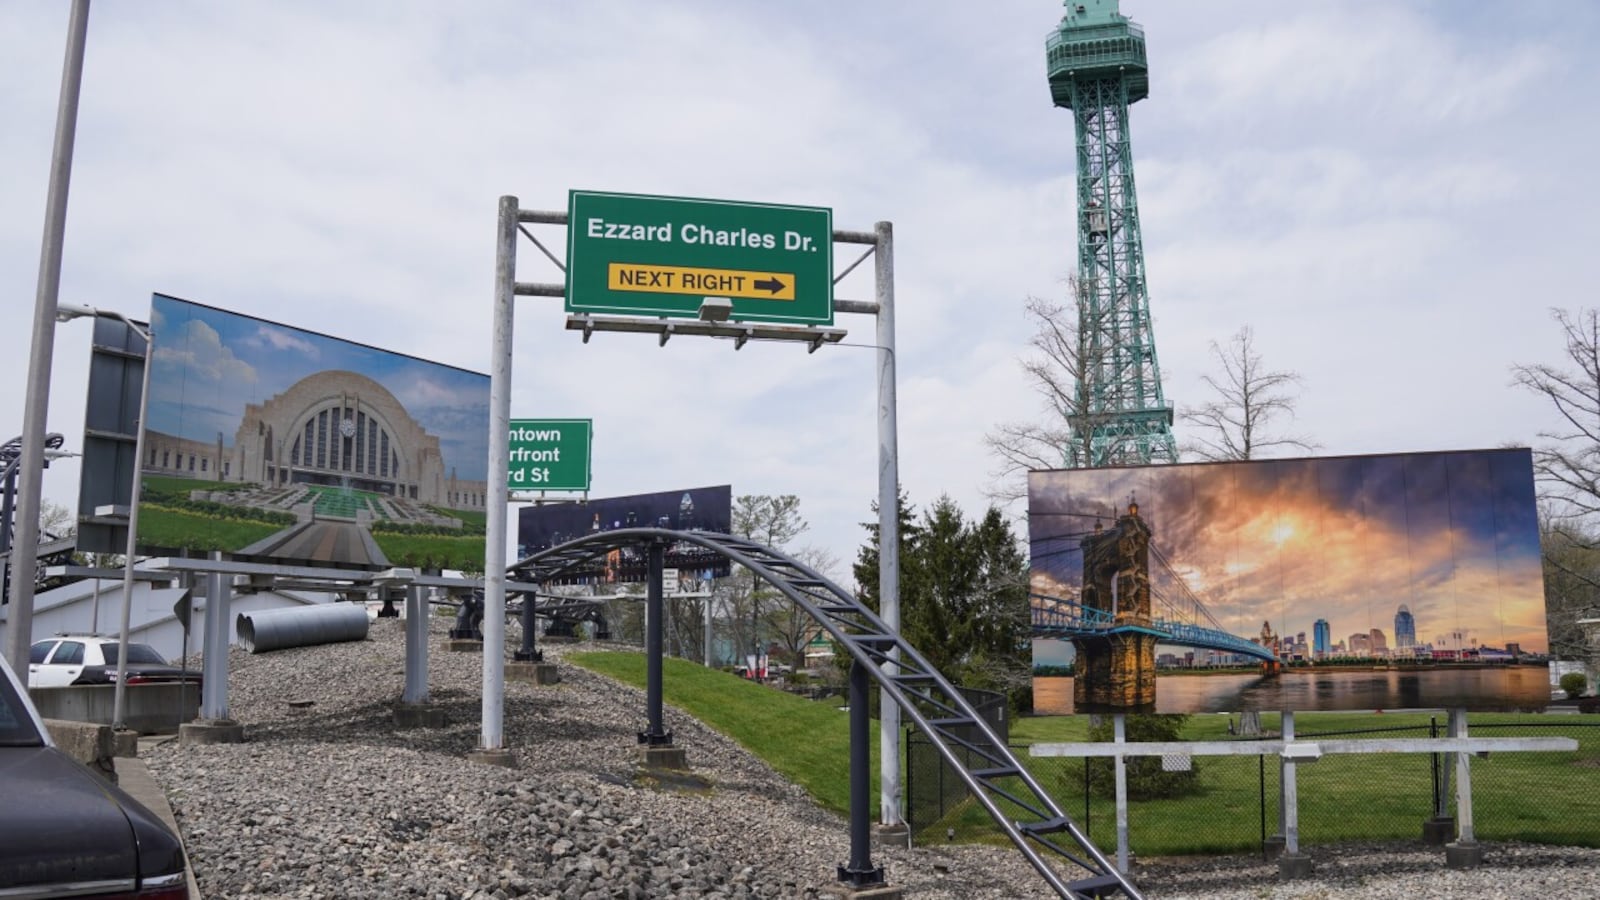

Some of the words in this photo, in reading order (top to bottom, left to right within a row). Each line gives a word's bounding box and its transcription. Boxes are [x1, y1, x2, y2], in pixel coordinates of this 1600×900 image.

[587, 218, 672, 242] Ezzard
[680, 223, 776, 249] Charles
[784, 231, 818, 253] Dr.
[619, 269, 676, 288] NEXT
[682, 272, 746, 292] RIGHT
[531, 467, 550, 482] St
